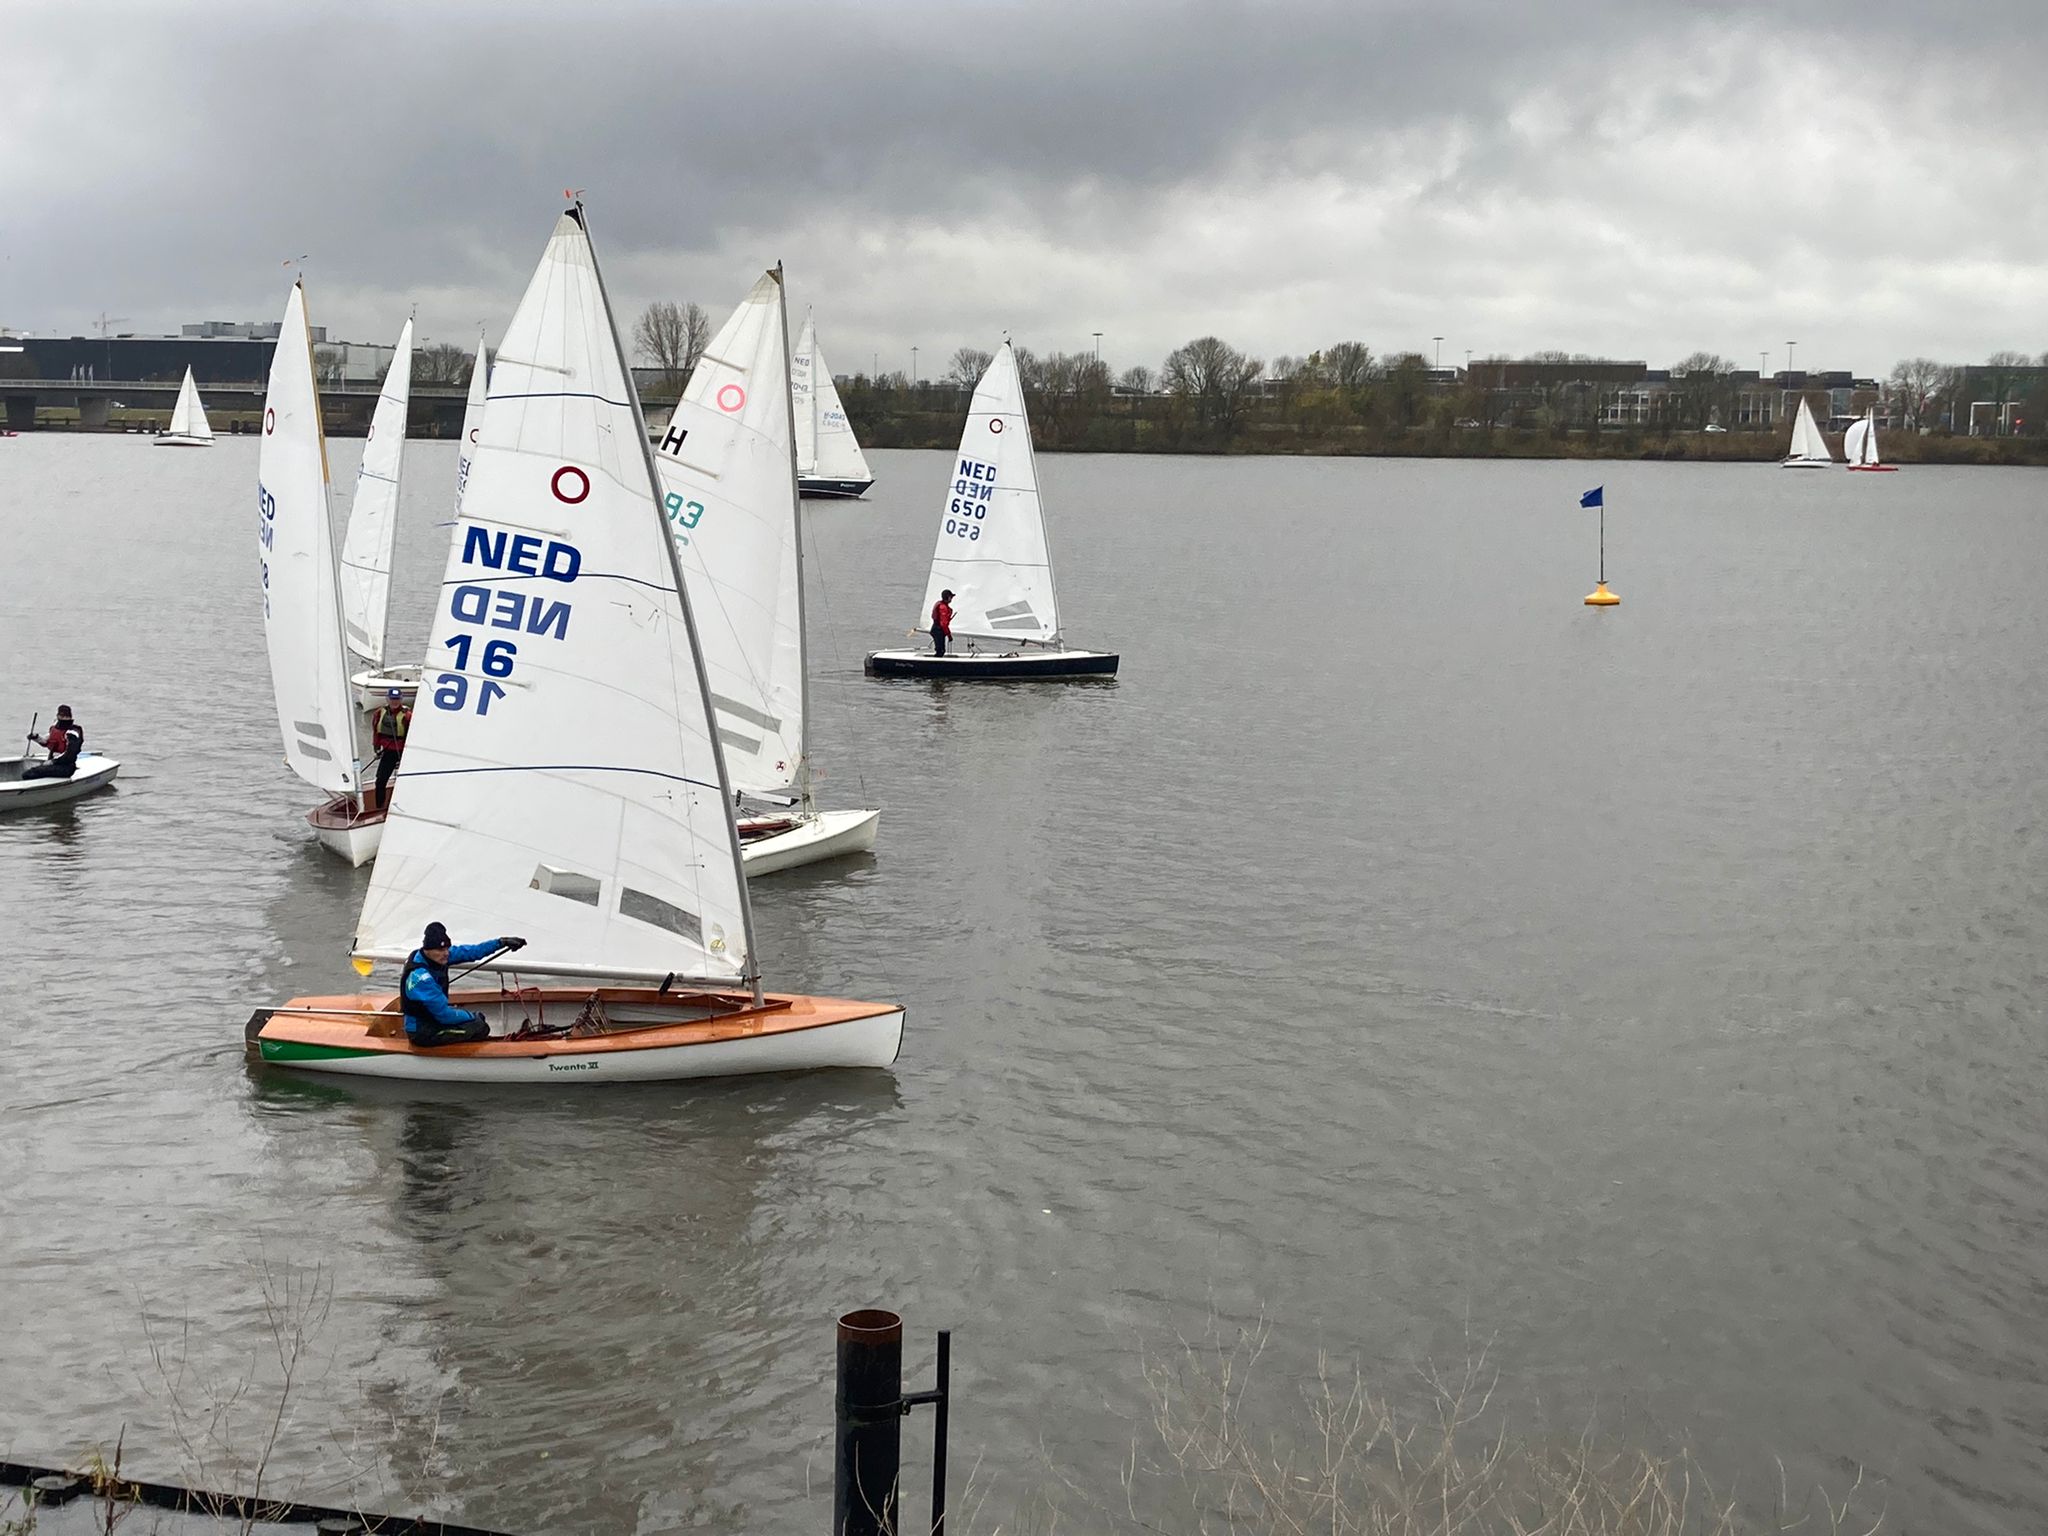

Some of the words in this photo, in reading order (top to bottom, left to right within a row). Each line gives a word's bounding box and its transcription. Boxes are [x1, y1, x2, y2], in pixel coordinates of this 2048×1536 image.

[660, 425, 689, 456] H
[959, 459, 997, 482] NED
[950, 498, 987, 520] 650
[461, 525, 582, 584] NED
[444, 633, 517, 679] 16
[548, 1063, 587, 1072] Twente
